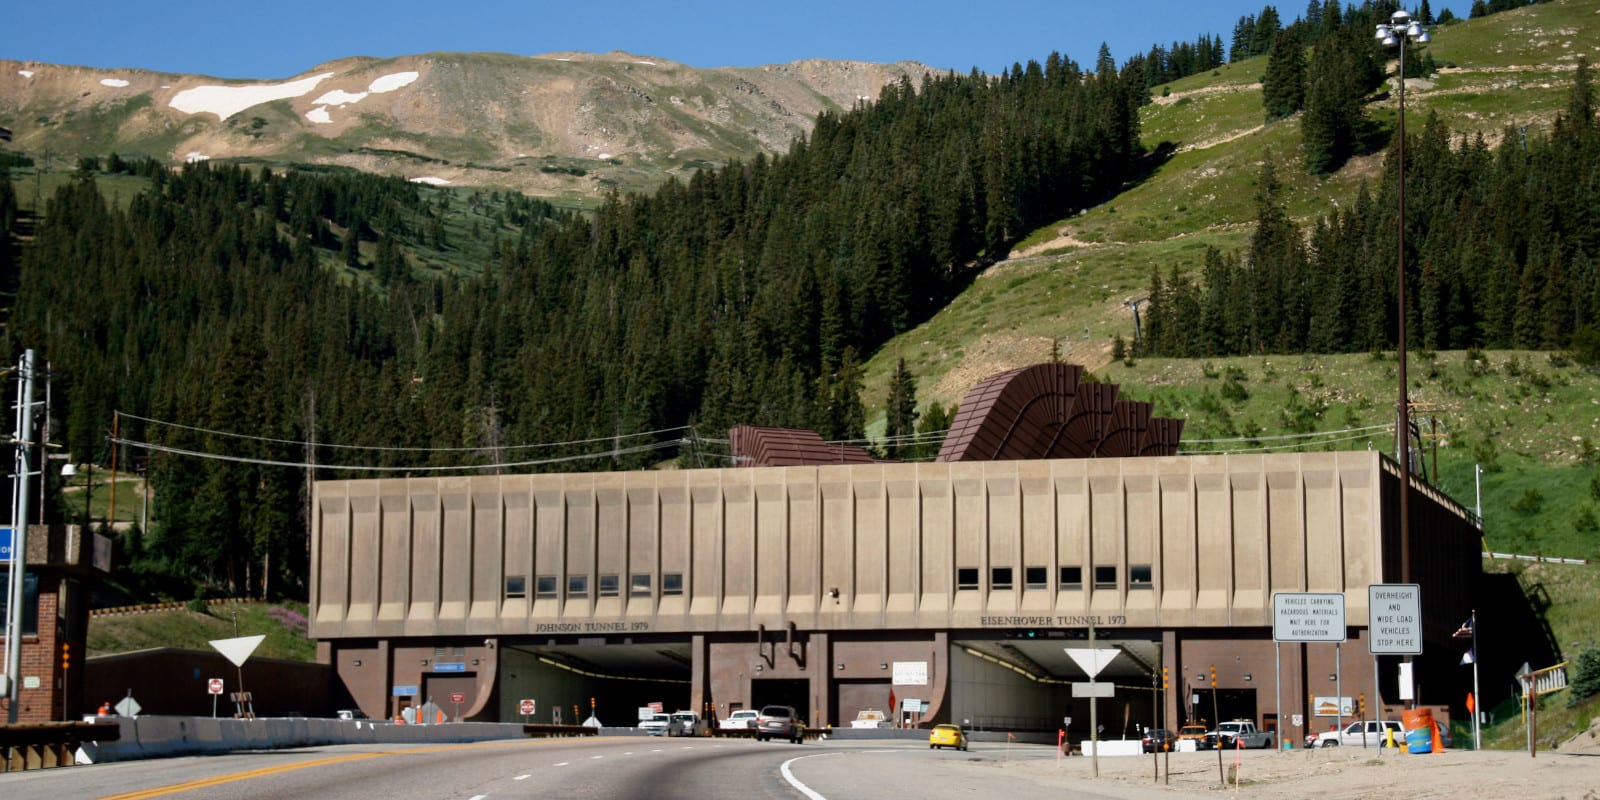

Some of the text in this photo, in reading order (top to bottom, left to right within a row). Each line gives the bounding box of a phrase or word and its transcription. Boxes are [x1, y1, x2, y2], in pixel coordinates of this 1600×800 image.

[981, 616, 1051, 625] EISENHOWER
[1108, 616, 1126, 624] 1973
[535, 622, 649, 633] JOHNSON TUNNEL 1979
[1380, 627, 1410, 635] VEHICLES
[1396, 639, 1414, 647] HERE
